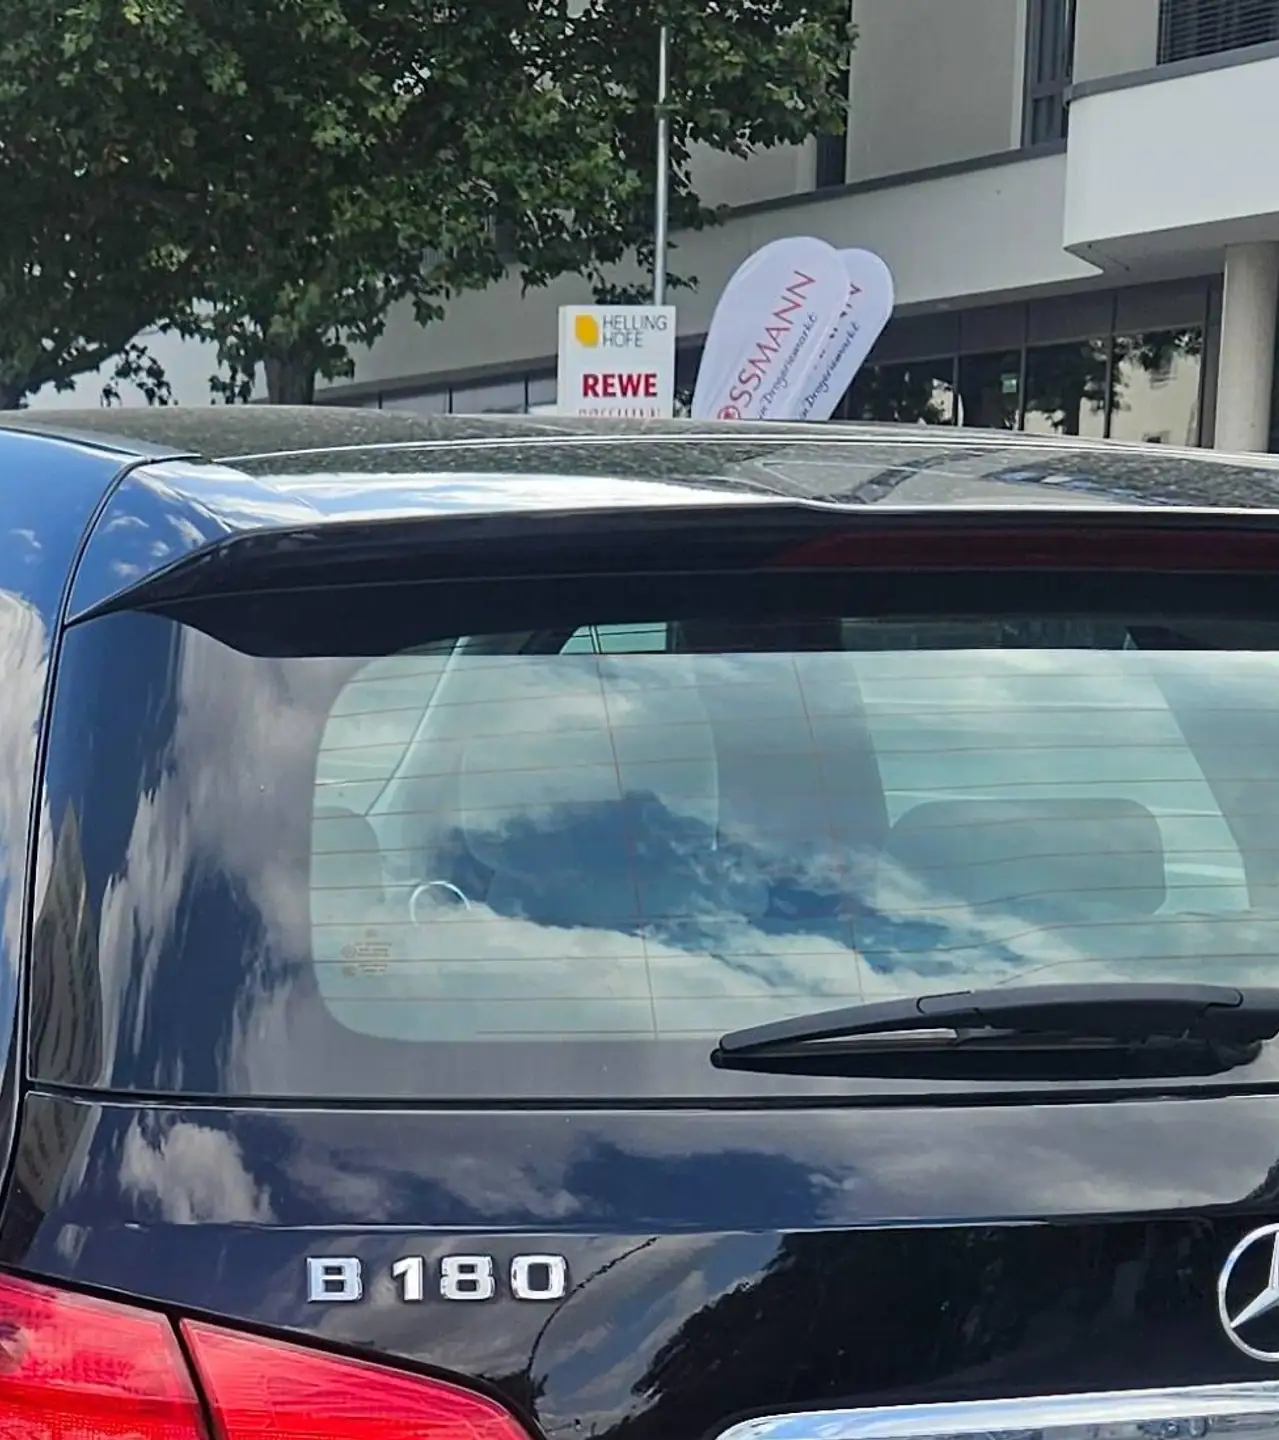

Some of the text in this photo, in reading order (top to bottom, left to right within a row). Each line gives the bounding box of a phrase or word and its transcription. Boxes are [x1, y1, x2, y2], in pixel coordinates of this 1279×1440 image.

[602, 314, 668, 331] HELLING
[583, 373, 658, 398] REWE
[306, 1255, 569, 1302] B 180
